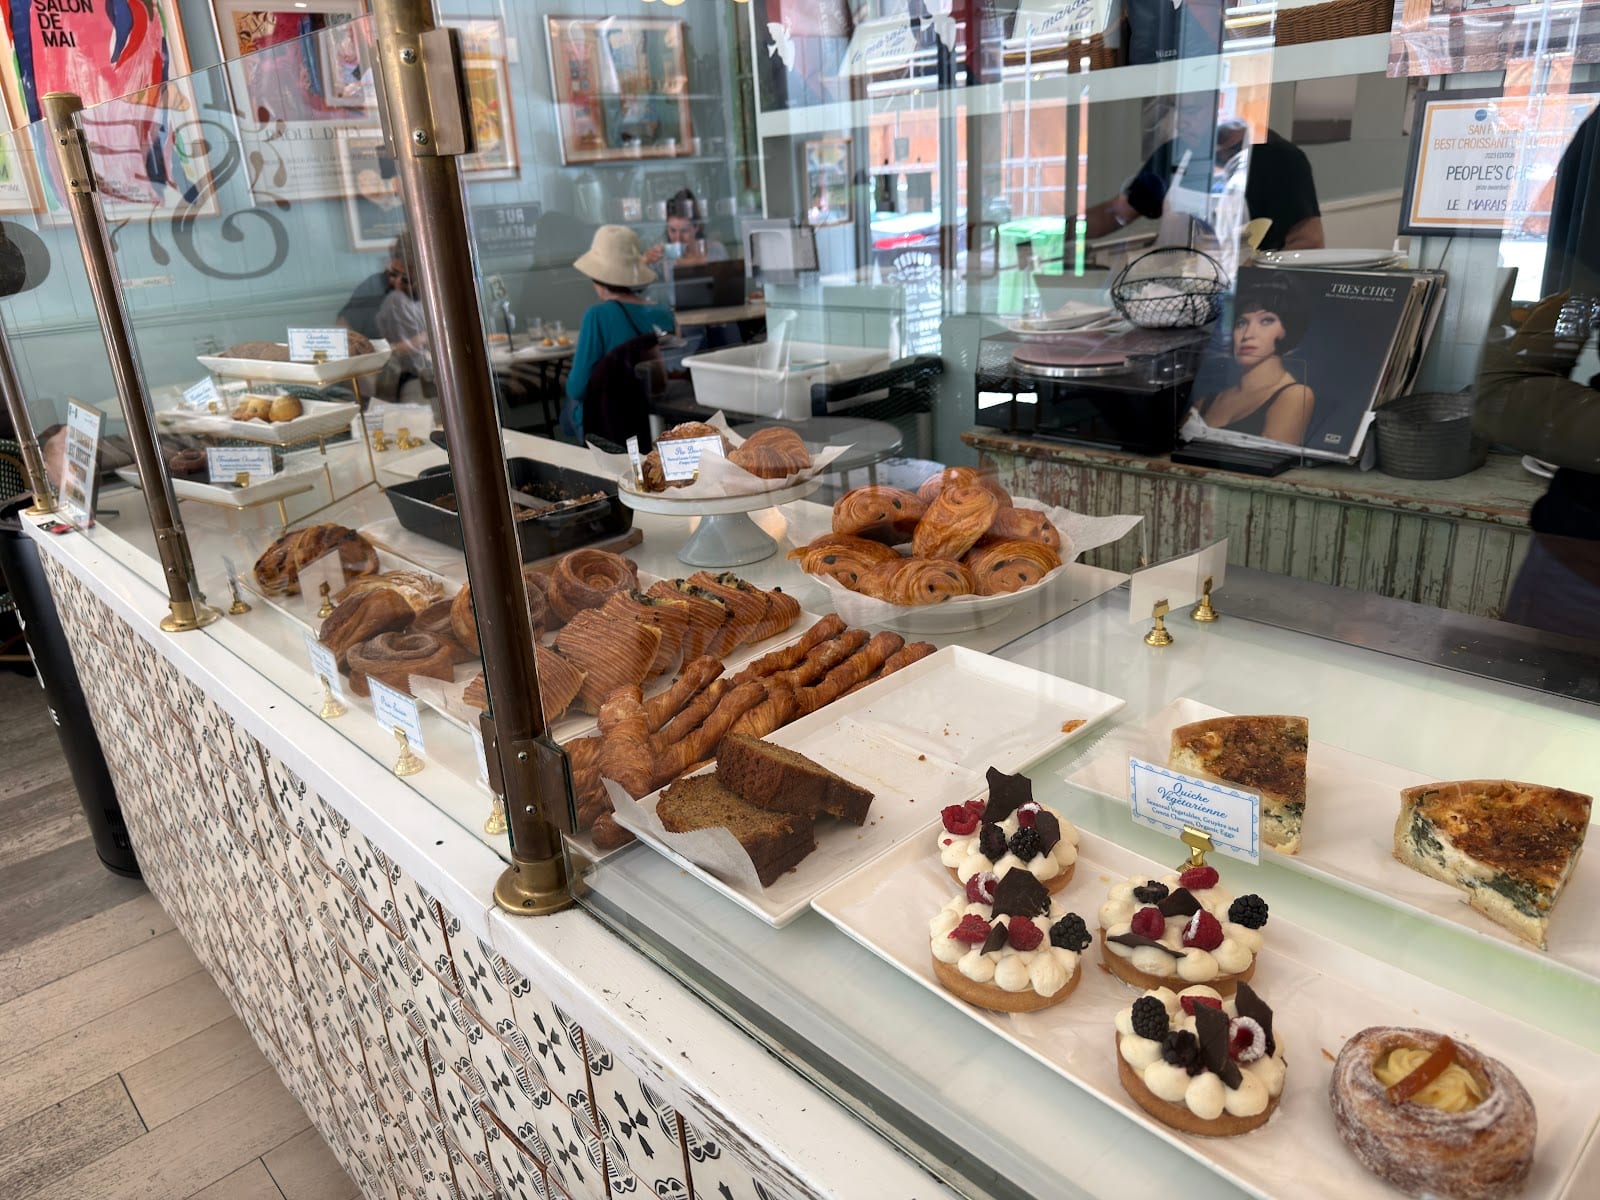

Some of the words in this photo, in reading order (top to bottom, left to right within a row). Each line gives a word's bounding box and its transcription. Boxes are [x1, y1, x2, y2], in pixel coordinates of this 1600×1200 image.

[33, 0, 94, 13] SALON
[37, 13, 63, 30] DE
[41, 31, 76, 47] MAI
[1468, 125, 1486, 135] SAN
[1434, 138, 1457, 149] BEST
[1457, 138, 1509, 149] CROISSANT
[1446, 165, 1503, 181] PEOPLE'S
[1447, 199, 1460, 211] LE
[1467, 199, 1507, 211] MARAIS
[1330, 283, 1360, 294] TRES
[1361, 286, 1396, 297] CHIC!
[1173, 782, 1210, 804] Quiche
